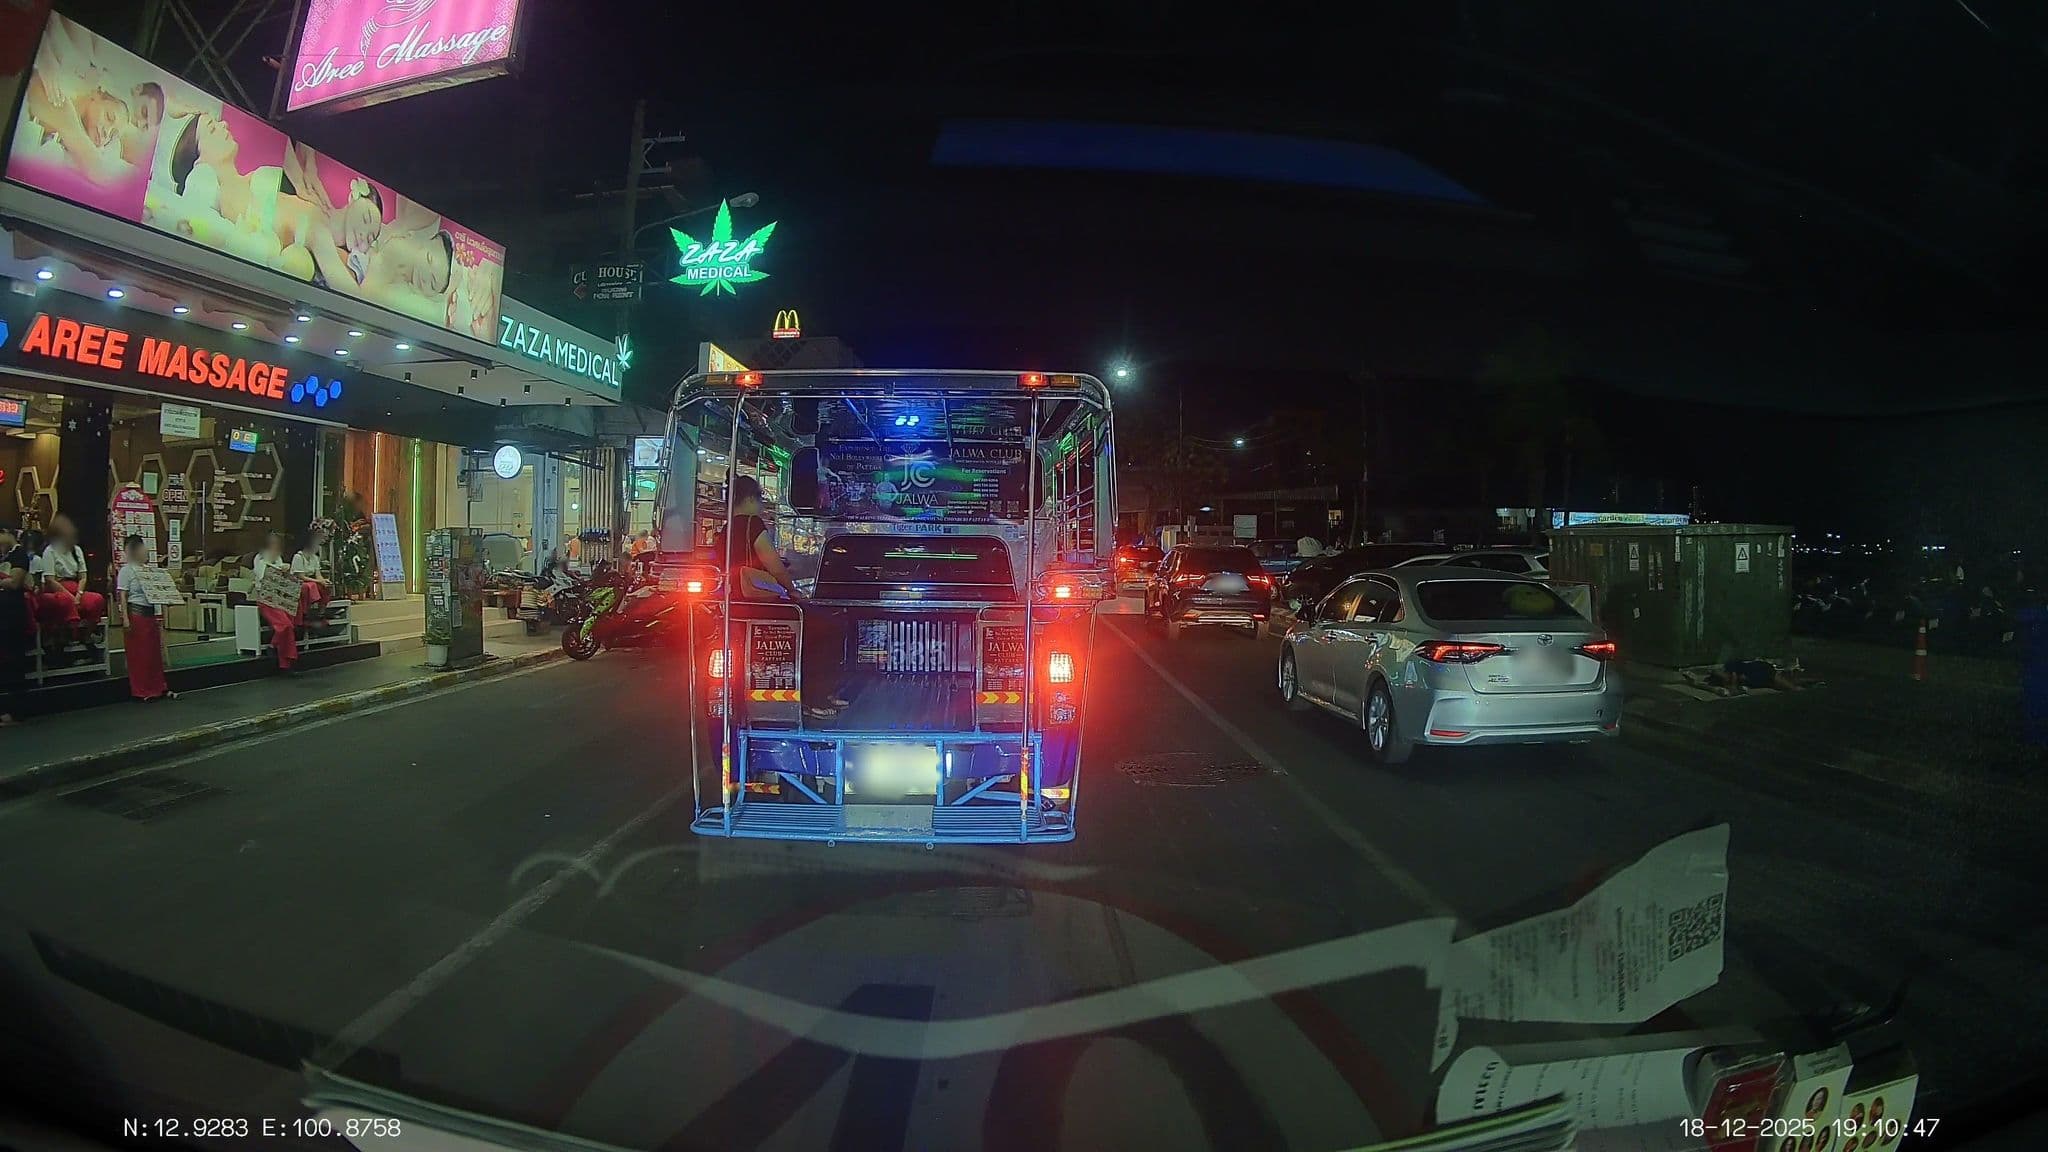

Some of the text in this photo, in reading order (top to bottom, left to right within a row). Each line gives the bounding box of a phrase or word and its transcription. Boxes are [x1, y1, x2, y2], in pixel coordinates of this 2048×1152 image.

[294, 21, 508, 92] Aree Massage
[681, 240, 762, 265] ZAZA
[687, 267, 752, 280] MEDICAL
[21, 312, 289, 399] AREE MASSAGE
[500, 315, 619, 386] ZAZA MEDICAL
[948, 448, 1022, 460] JALWA CLUB
[163, 488, 189, 502] OPEN
[896, 493, 939, 506] JALWA
[915, 524, 942, 532] PARK
[756, 641, 792, 650] JALWA
[988, 642, 1025, 652] JALWA
